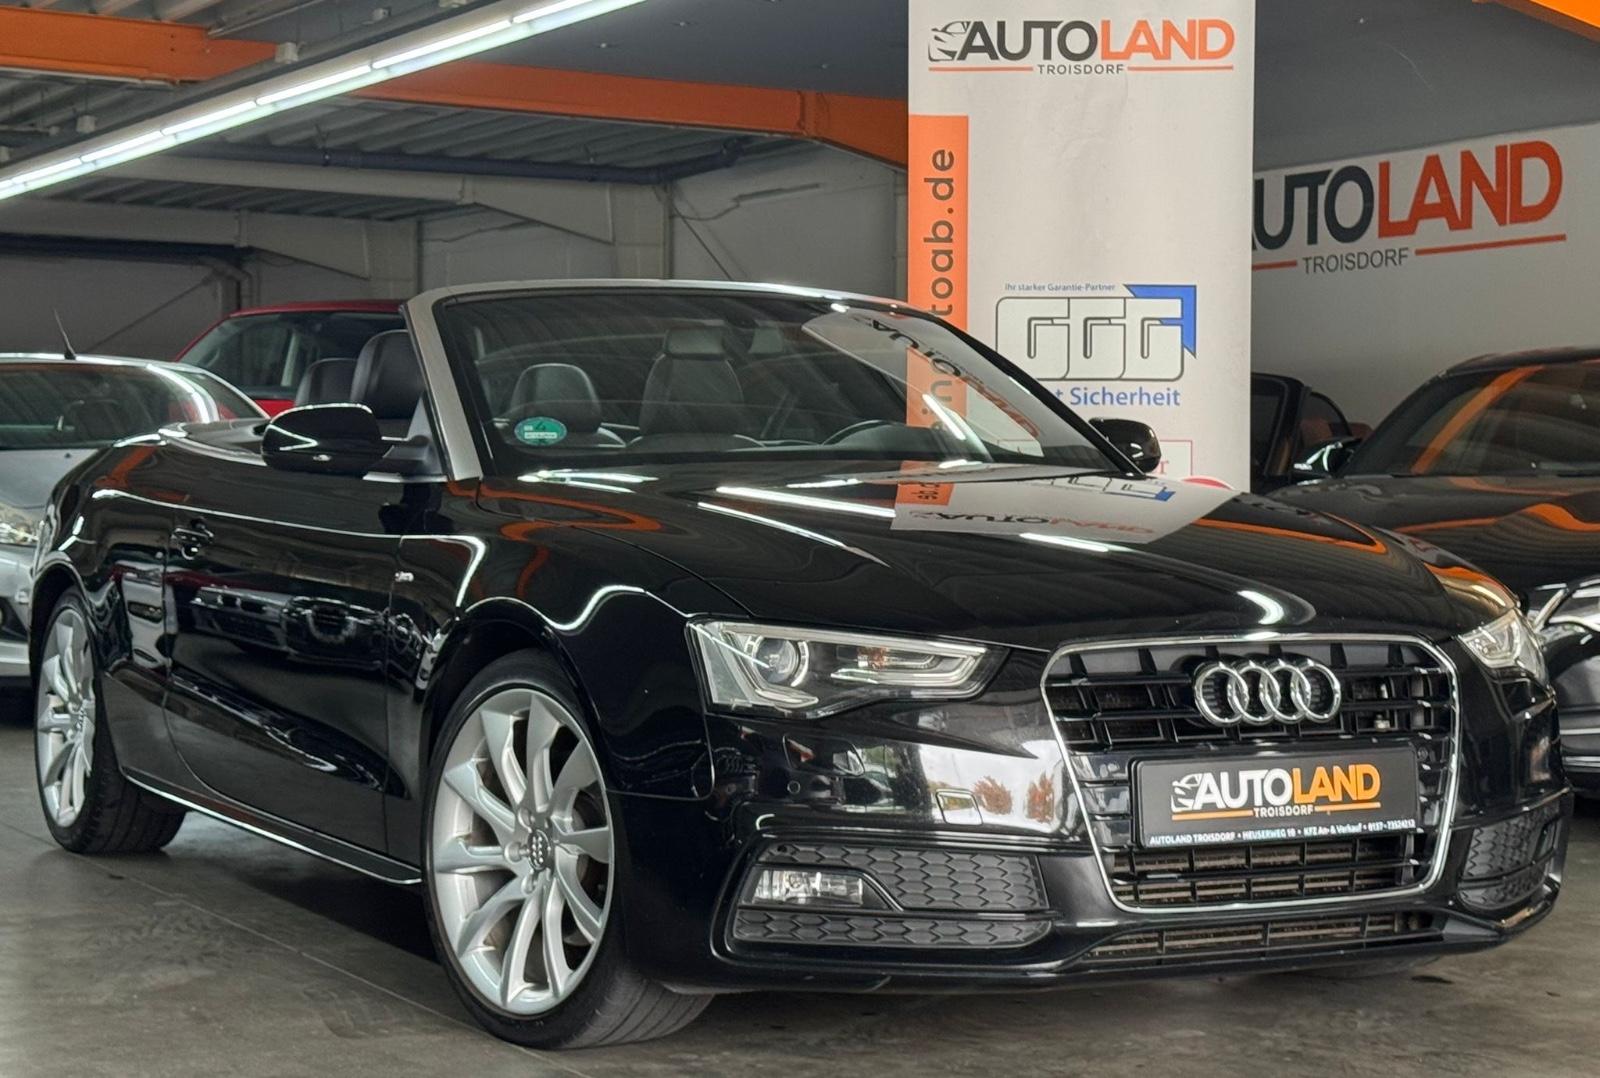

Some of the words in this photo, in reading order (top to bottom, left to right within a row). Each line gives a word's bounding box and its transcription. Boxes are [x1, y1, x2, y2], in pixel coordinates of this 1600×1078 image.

[957, 19, 1235, 61] AUTOLAND
[1037, 64, 1124, 75] TROISDORF
[1252, 140, 1563, 251] UTOLAND
[1302, 247, 1409, 274] TROISDORF
[1005, 283, 1016, 291] Ihr
[1018, 283, 1045, 291] starker
[1047, 283, 1115, 292] Garantie-Partner
[1070, 386, 1180, 406] Sicherheit
[1192, 763, 1381, 810] AUTOLAND
[1254, 805, 1314, 818] TROISDORF
[1150, 834, 1192, 845] AUTOLAND
[1193, 831, 1235, 842] TROISDORF
